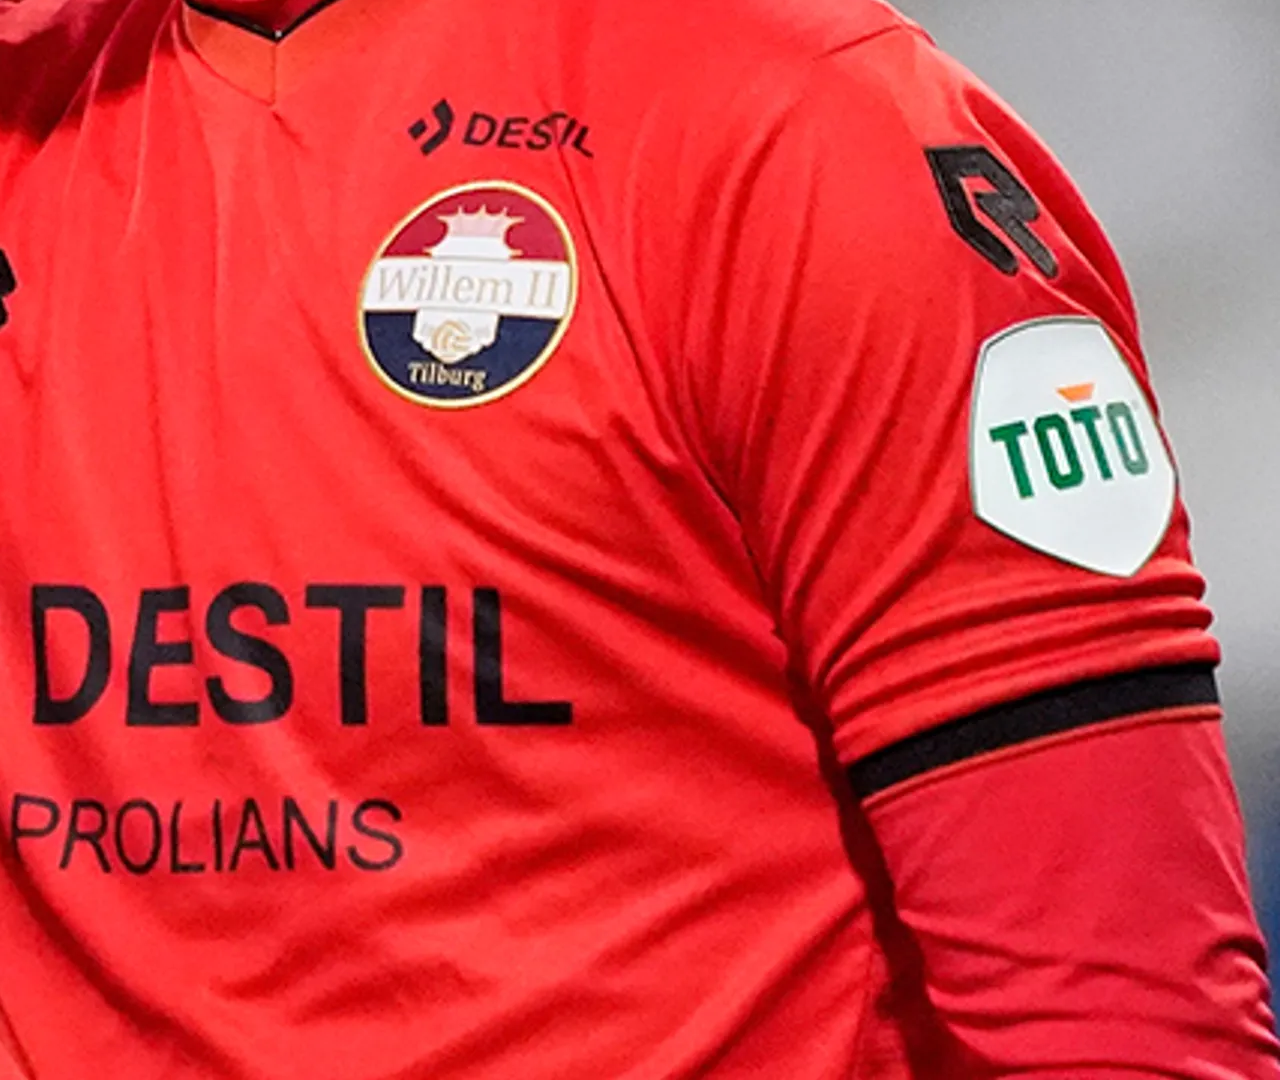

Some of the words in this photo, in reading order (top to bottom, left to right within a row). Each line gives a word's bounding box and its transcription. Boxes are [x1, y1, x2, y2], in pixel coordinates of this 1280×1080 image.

[378, 264, 514, 305] Willem
[524, 269, 561, 308] II
[408, 362, 487, 392] Tilburg
[989, 402, 1149, 500] TOTO
[30, 582, 573, 727] DESTIL
[11, 793, 404, 873] PROLIANS
